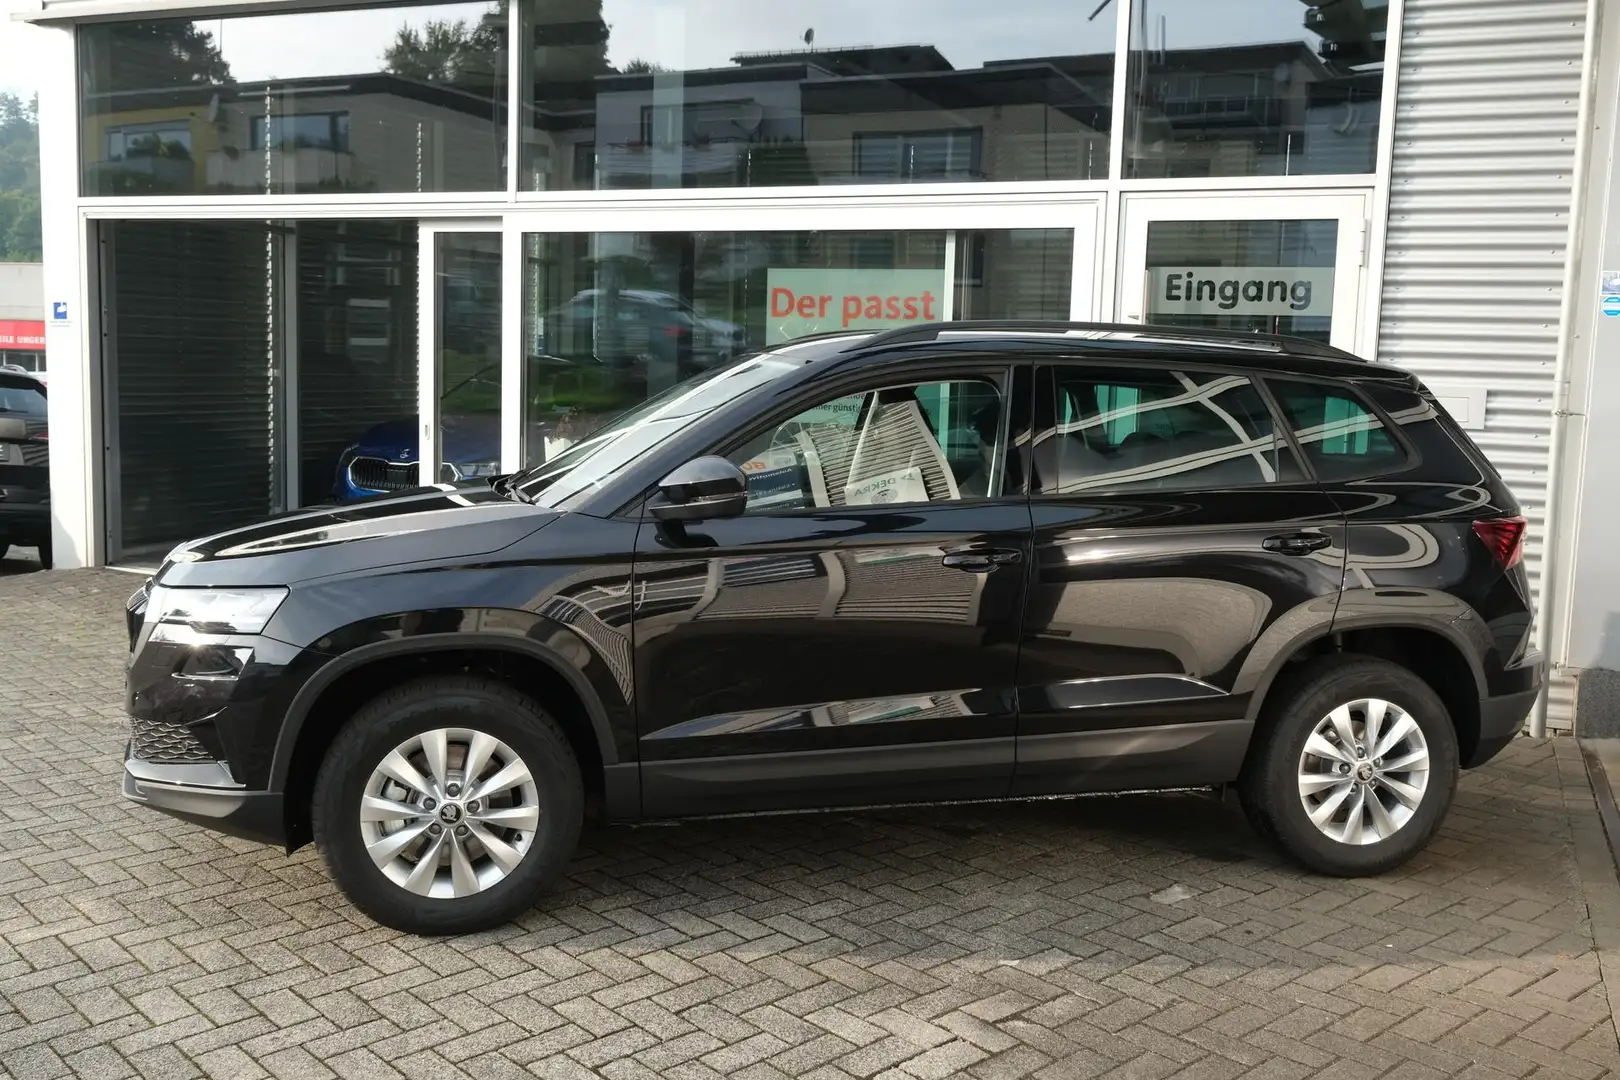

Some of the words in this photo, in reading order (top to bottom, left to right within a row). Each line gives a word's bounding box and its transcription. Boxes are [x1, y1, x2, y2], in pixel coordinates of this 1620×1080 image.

[771, 287, 833, 319] Der
[841, 290, 936, 329] passt
[1165, 271, 1312, 311] Eingang
